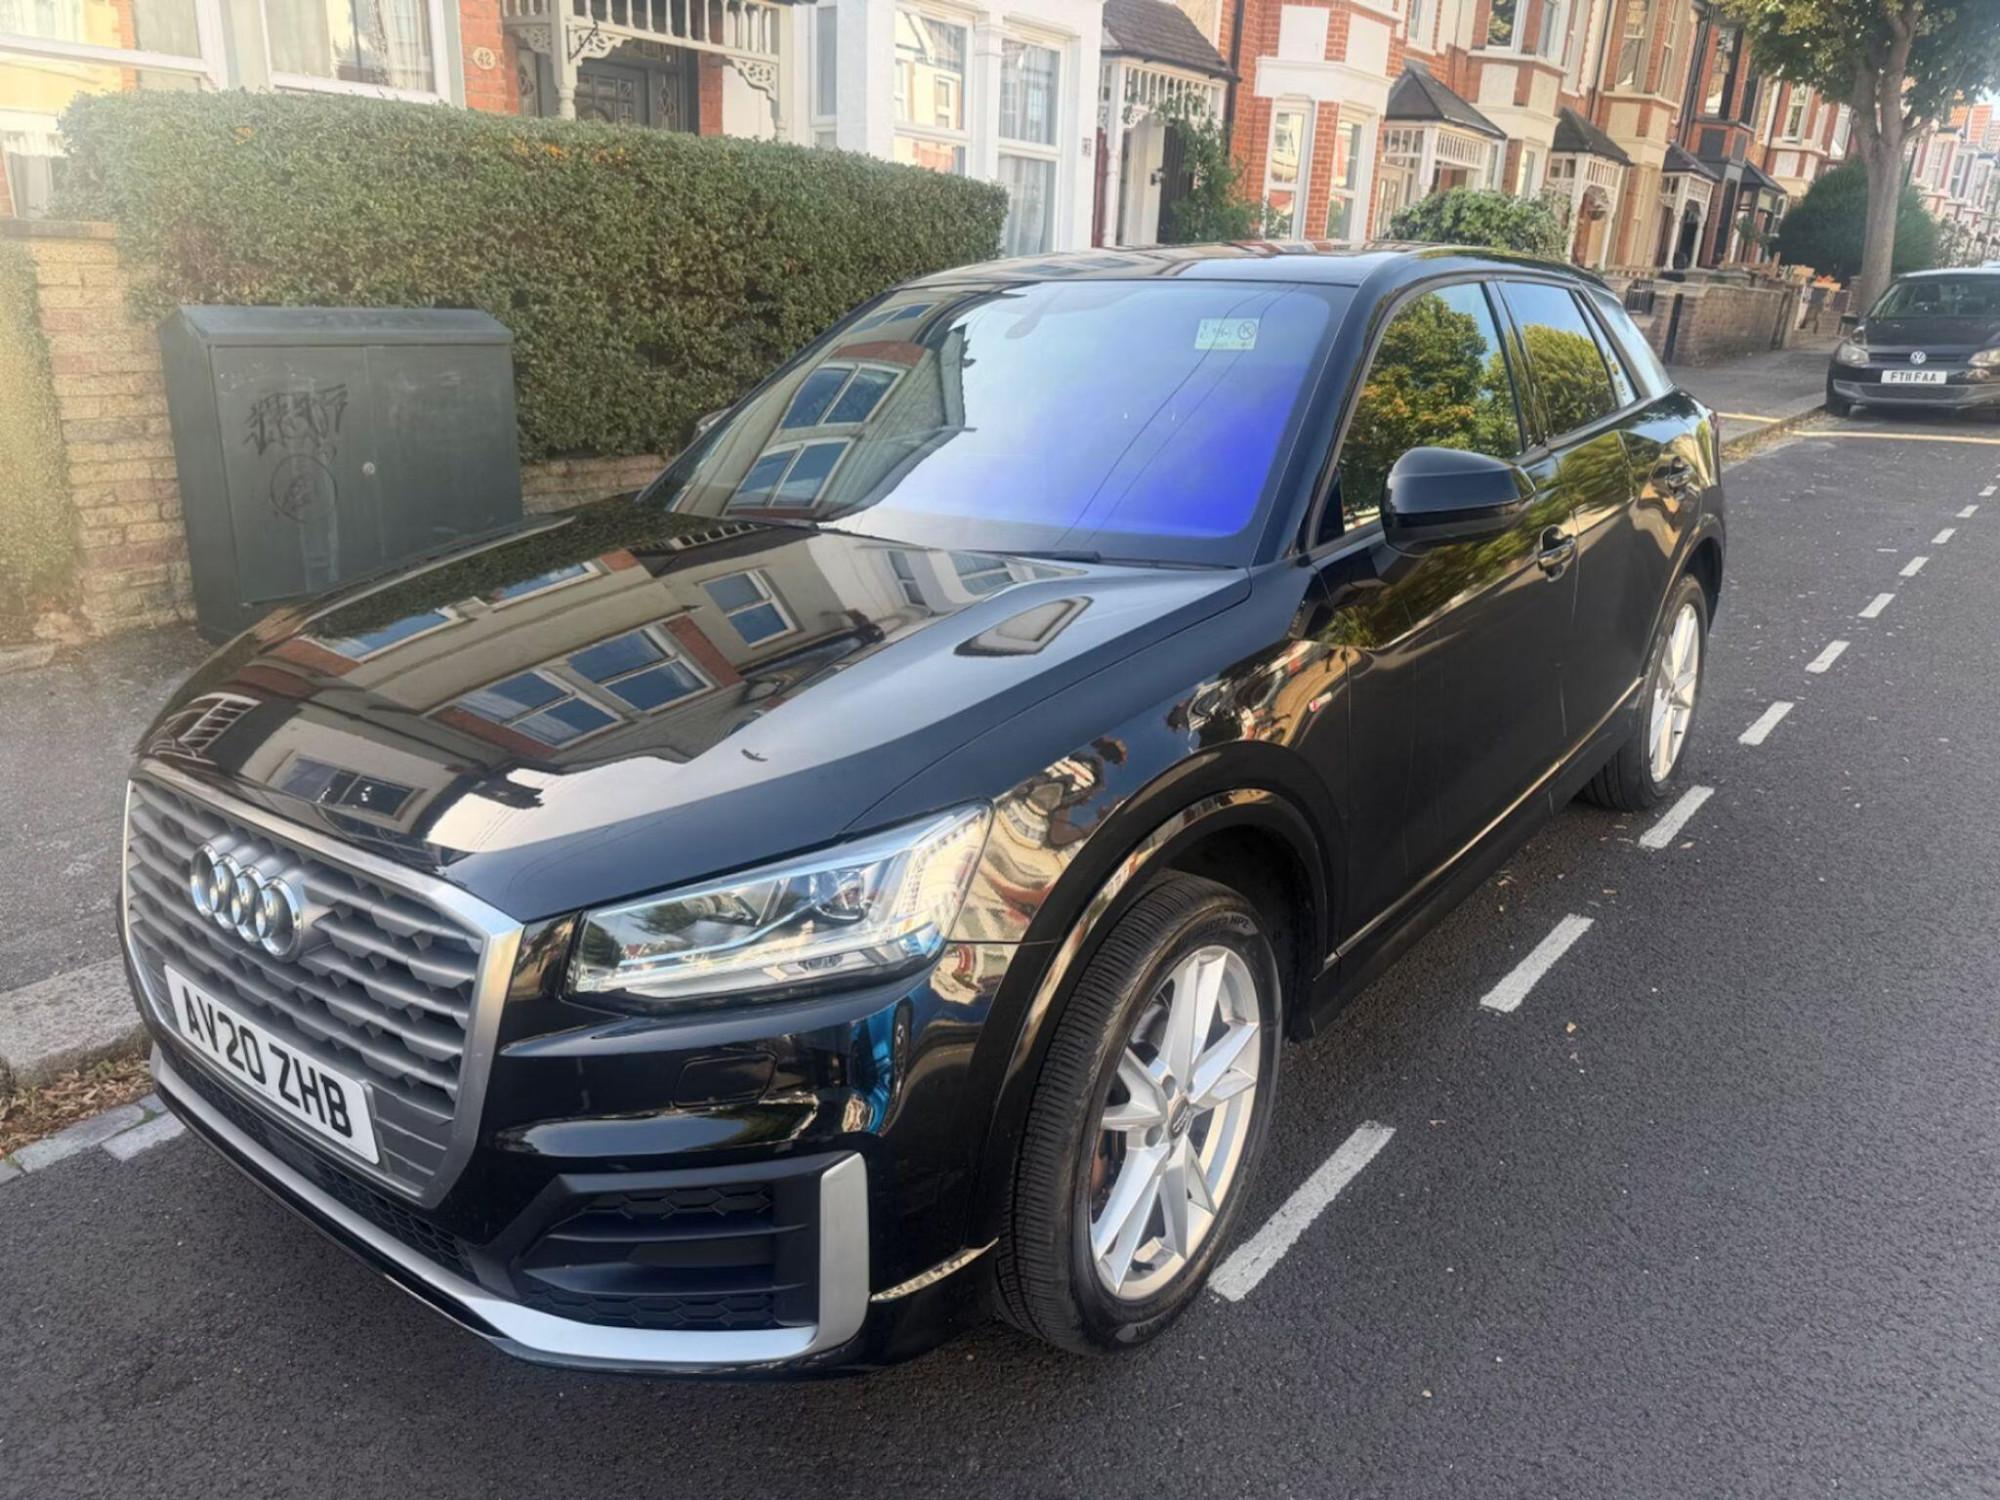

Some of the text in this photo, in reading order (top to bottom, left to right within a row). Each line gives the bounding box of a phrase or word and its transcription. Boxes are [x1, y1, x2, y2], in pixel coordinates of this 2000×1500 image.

[1914, 371, 1937, 382] FAA
[182, 985, 353, 1138] AV20 ZHB
